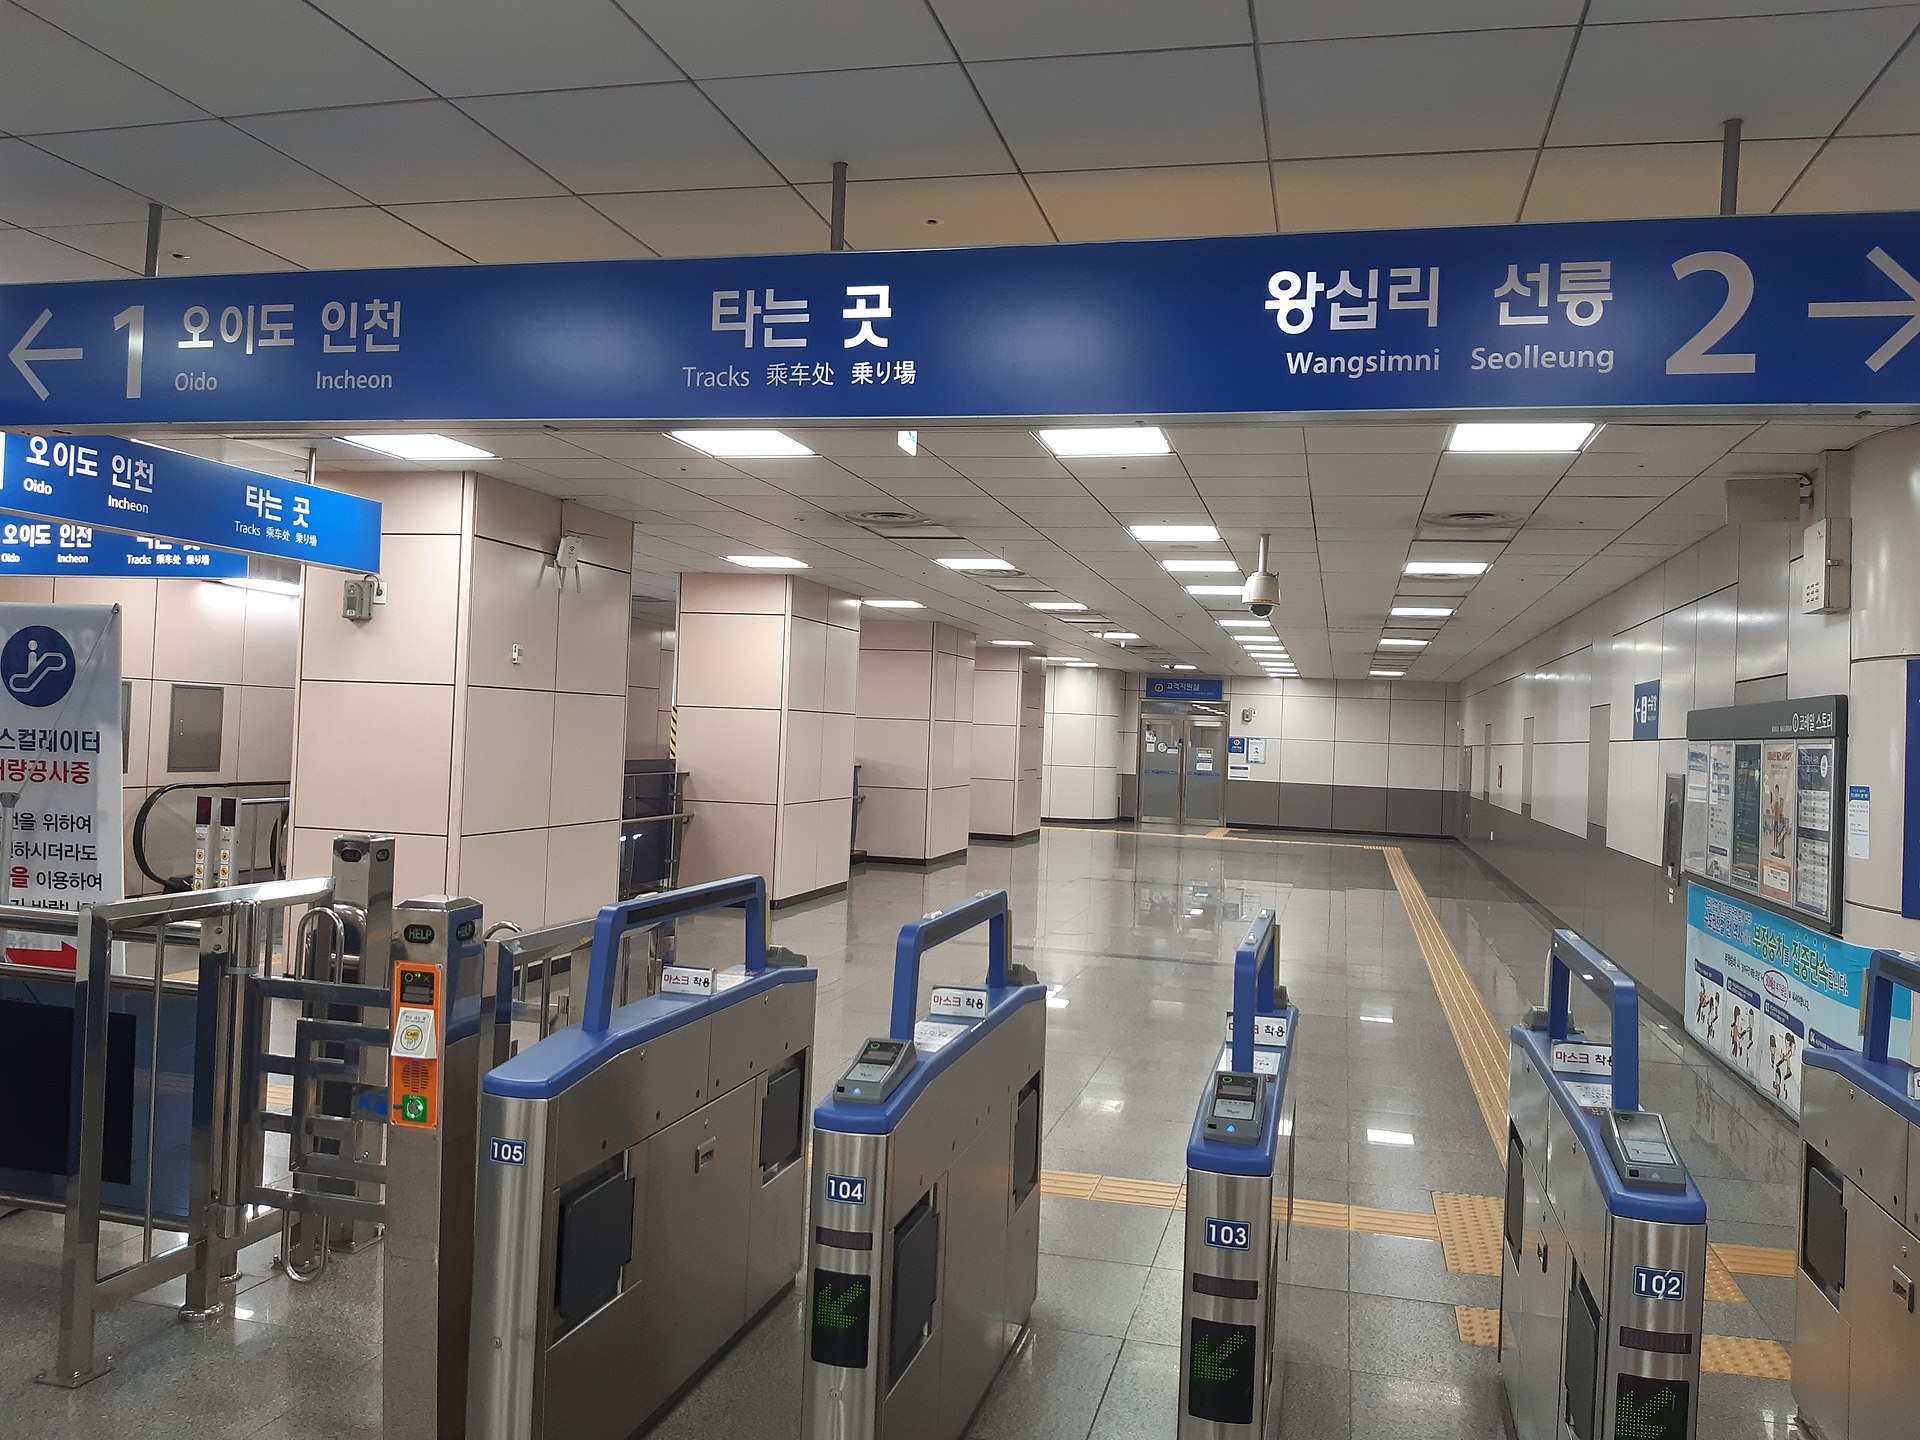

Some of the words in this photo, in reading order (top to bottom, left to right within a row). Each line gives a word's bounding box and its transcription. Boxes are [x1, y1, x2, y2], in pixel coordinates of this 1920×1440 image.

[712, 288, 810, 348] 타는
[842, 285, 892, 349] 곳
[1265, 265, 1440, 335] 왕십리
[1493, 260, 1614, 327] 선릉
[1665, 250, 1757, 375] 2
[113, 305, 145, 399] 1
[177, 303, 295, 355] 오이도
[321, 298, 401, 353] 인천
[1286, 348, 1441, 379] Wangsimni
[1471, 345, 1615, 374] Seolleung
[174, 371, 218, 392] Oido
[316, 370, 393, 390] Incheon
[683, 365, 750, 388] Tracks
[766, 362, 835, 387] 乘车处
[851, 360, 916, 385] 乗り場
[25, 435, 99, 478] 오이도
[111, 453, 155, 494] 인천
[23, 478, 53, 496] Oido
[107, 494, 149, 514] Incheon
[246, 484, 283, 522] 타는
[293, 496, 311, 528] 곳
[2, 524, 52, 548] 오이도
[234, 520, 261, 537] Tracks
[1, 553, 21, 563] Oido
[57, 553, 89, 564] Incheon
[126, 554, 152, 565] Tracks
[1798, 713, 1815, 732] 코레일
[1815, 711, 1834, 731] 스토리
[42, 813, 92, 834] 위하여
[36, 871, 103, 892] 이용하여
[408, 928, 433, 940] HELP
[458, 924, 473, 938] HELP
[1753, 922, 1790, 967] 부정승차를
[663, 974, 690, 986] 마스크
[693, 976, 710, 988] 착용
[933, 995, 961, 1007] 마스크
[966, 997, 984, 1010] 착용
[1264, 1025, 1286, 1038] 착용
[1555, 1050, 1590, 1064] 마스크
[492, 1141, 523, 1162] 105
[829, 1178, 863, 1201] 104
[1208, 1223, 1248, 1246] 103
[1637, 1272, 1682, 1297] 102
